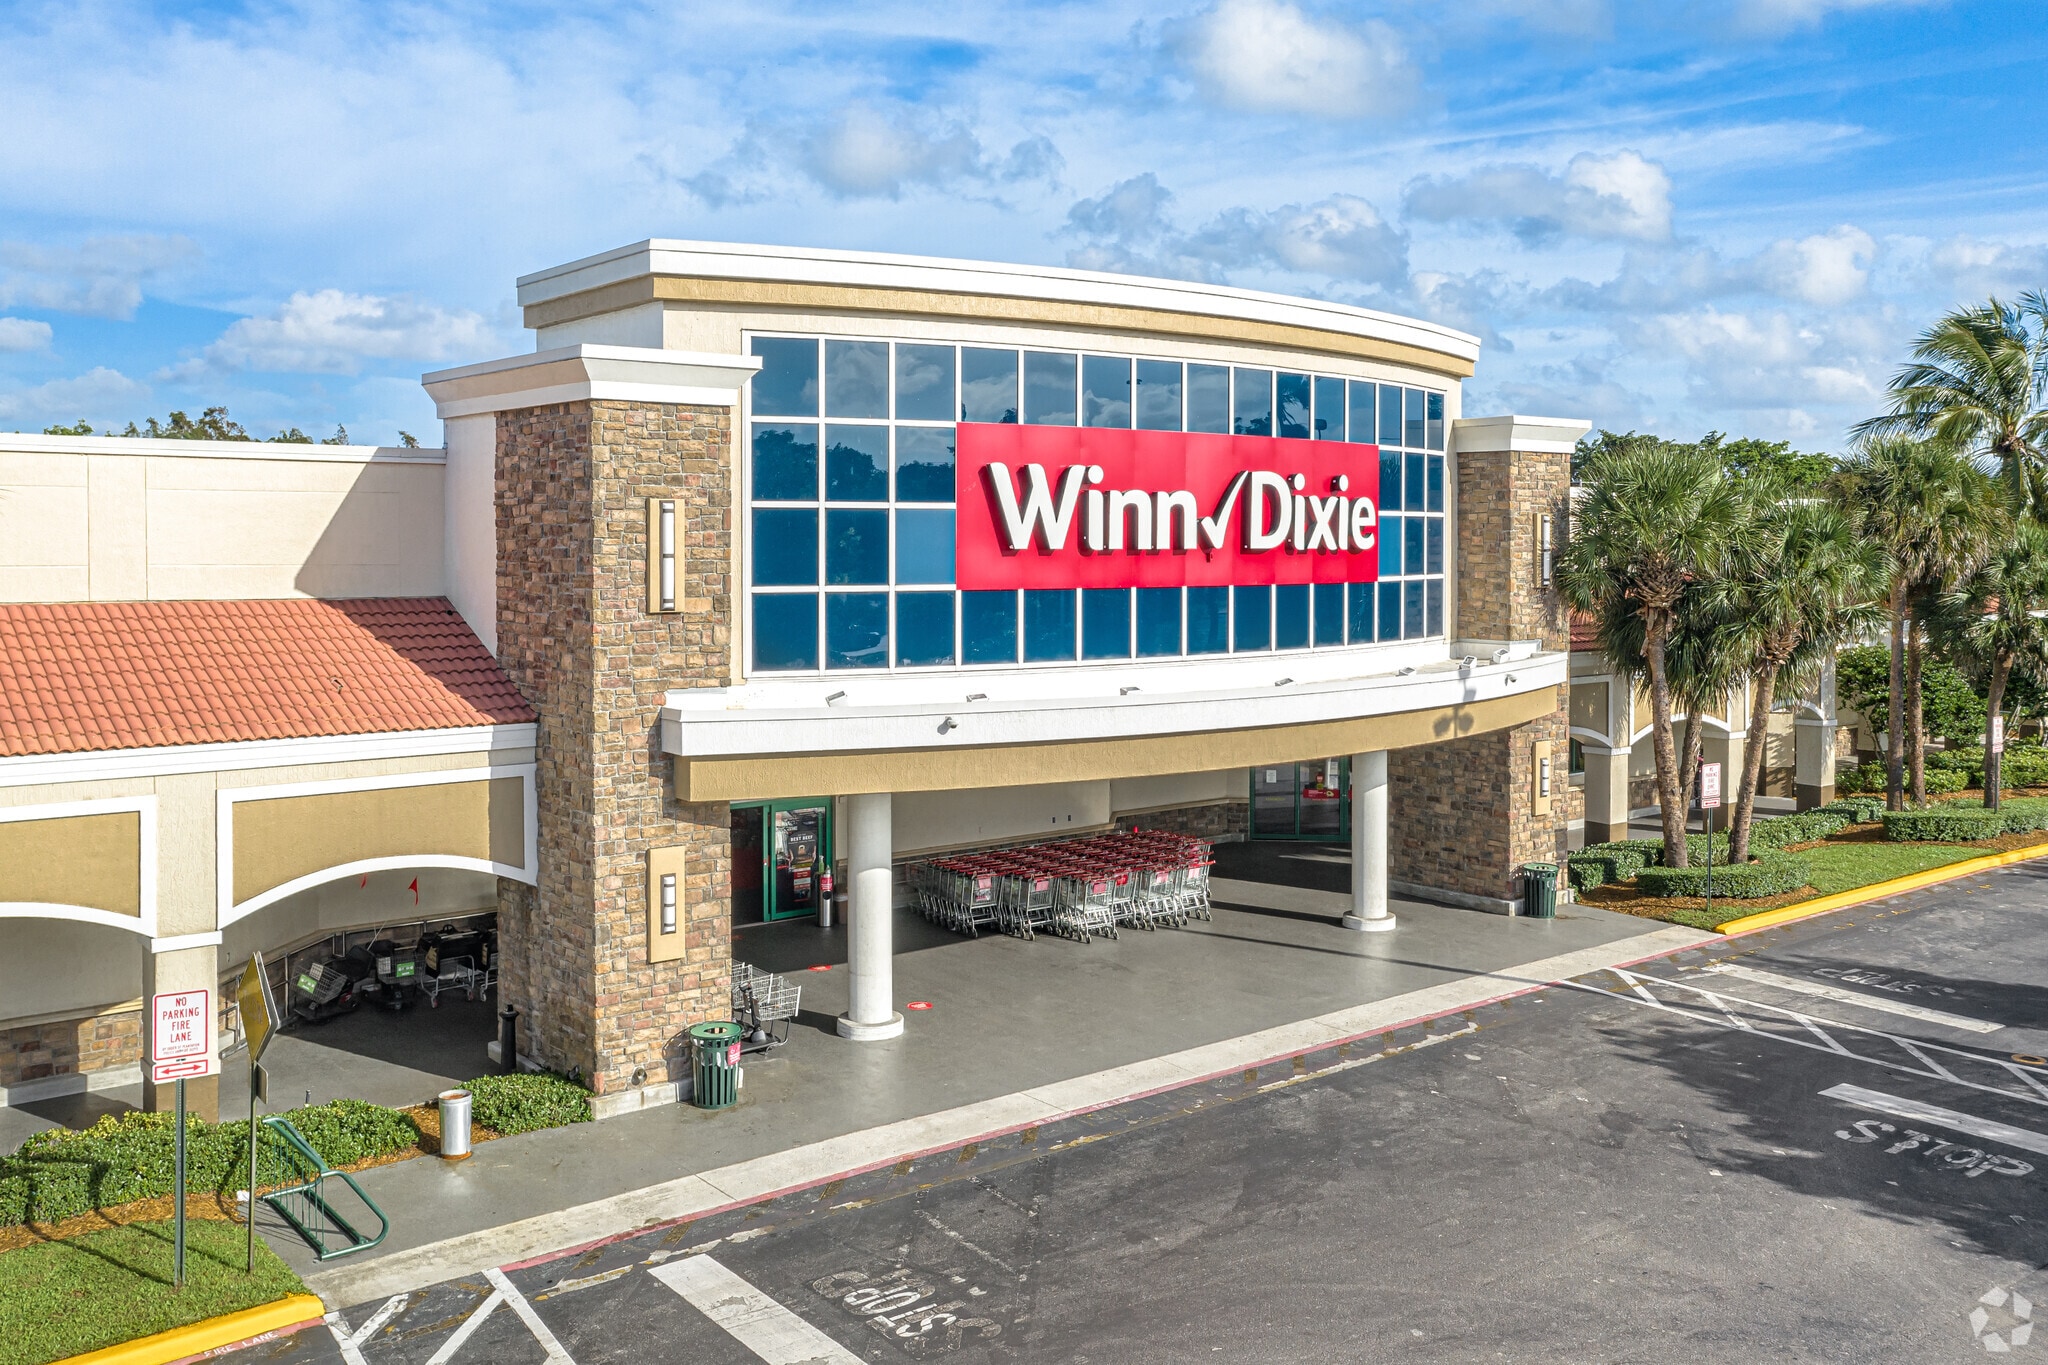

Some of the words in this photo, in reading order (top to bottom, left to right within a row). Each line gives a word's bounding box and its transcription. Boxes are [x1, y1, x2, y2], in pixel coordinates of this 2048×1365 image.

[981, 461, 1198, 553] Winn
[1243, 470, 1377, 553] Dixie
[175, 996, 187, 1007] NO
[162, 1006, 200, 1021] PARKING
[171, 1020, 191, 1031] FIRE
[170, 1031, 192, 1043] LANE
[203, 1344, 236, 1357] FIRE
[241, 1331, 279, 1347] LANE
